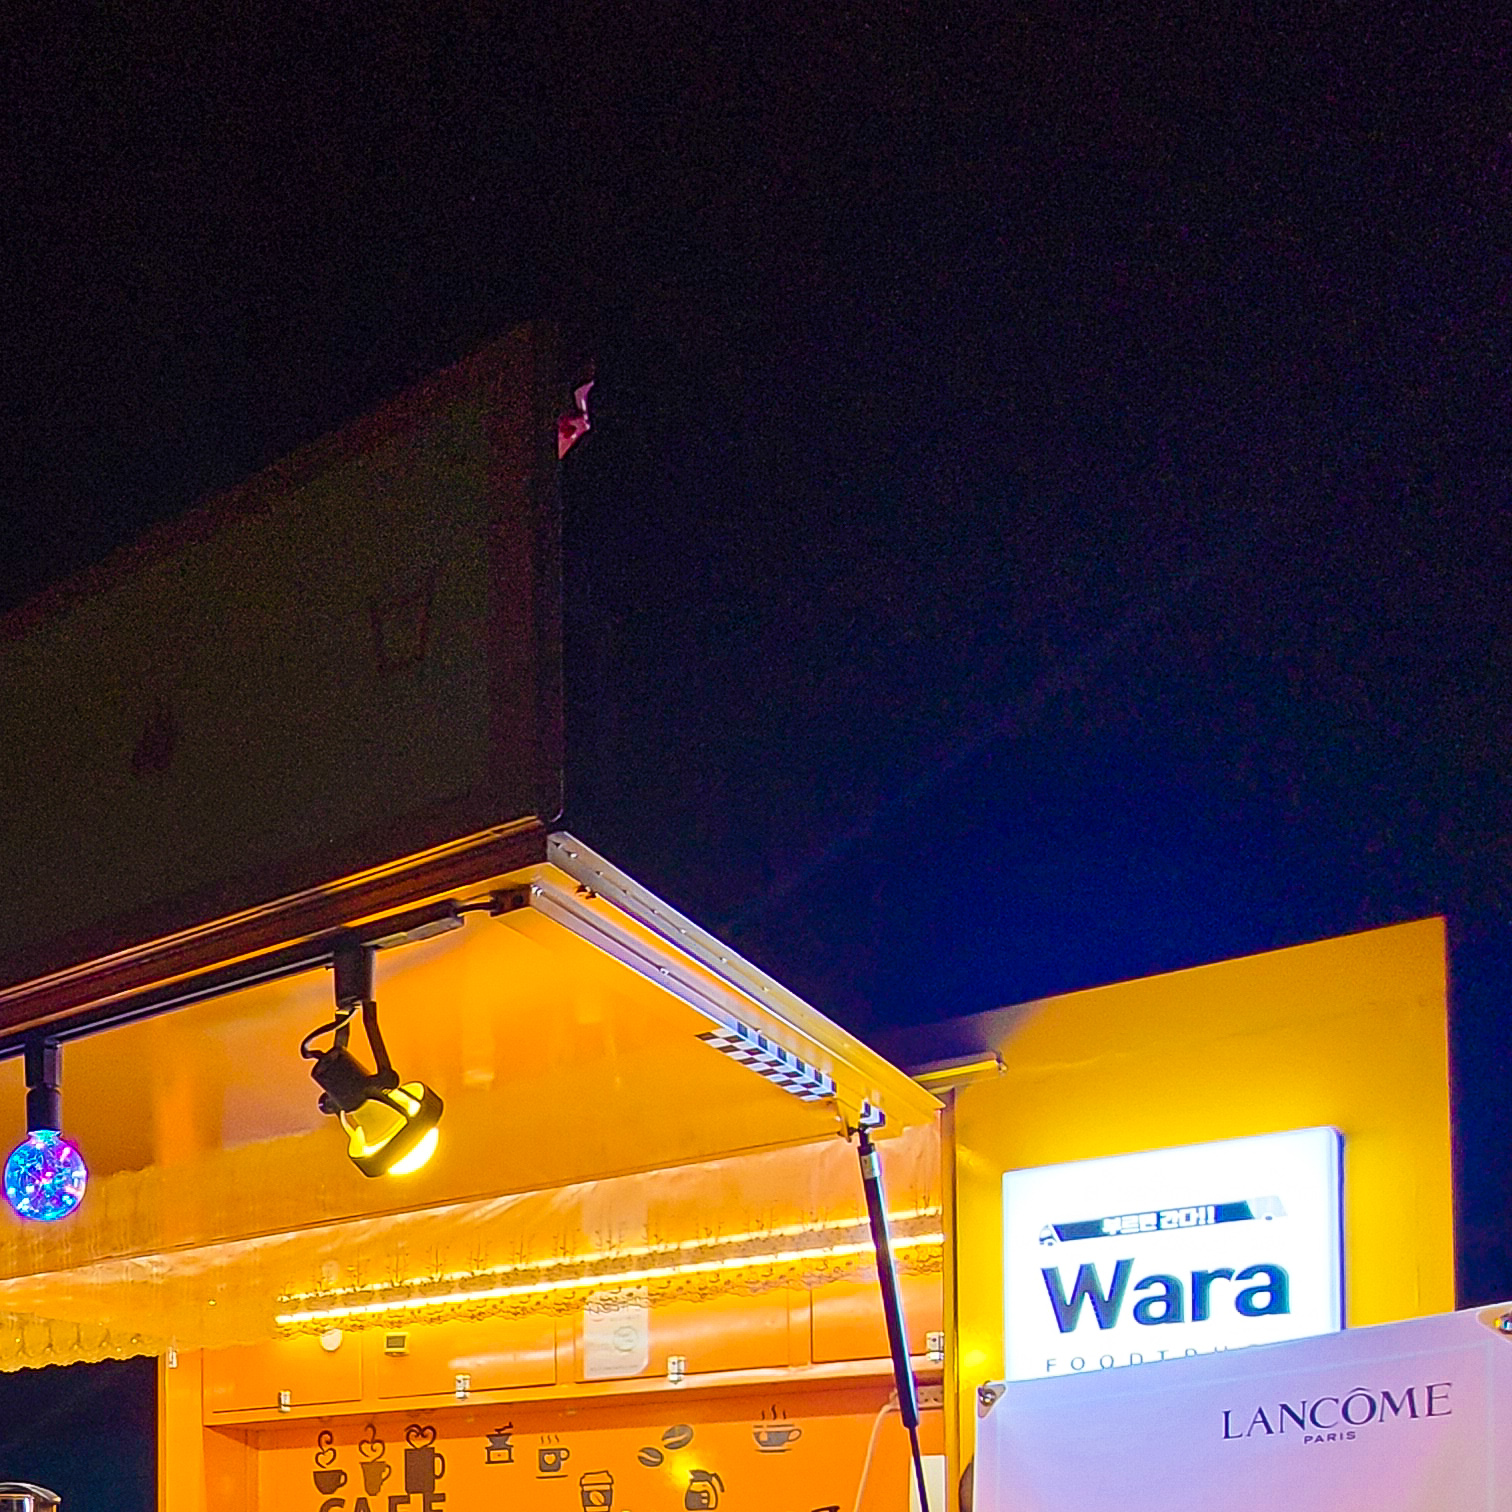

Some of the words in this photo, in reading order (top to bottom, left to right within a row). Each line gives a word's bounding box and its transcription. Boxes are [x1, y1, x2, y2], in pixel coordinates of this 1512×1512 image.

[1041, 1258, 1290, 1334] Wara
[1222, 1382, 1452, 1440] LANCÔME
[1304, 1430, 1356, 1445] PARIS
